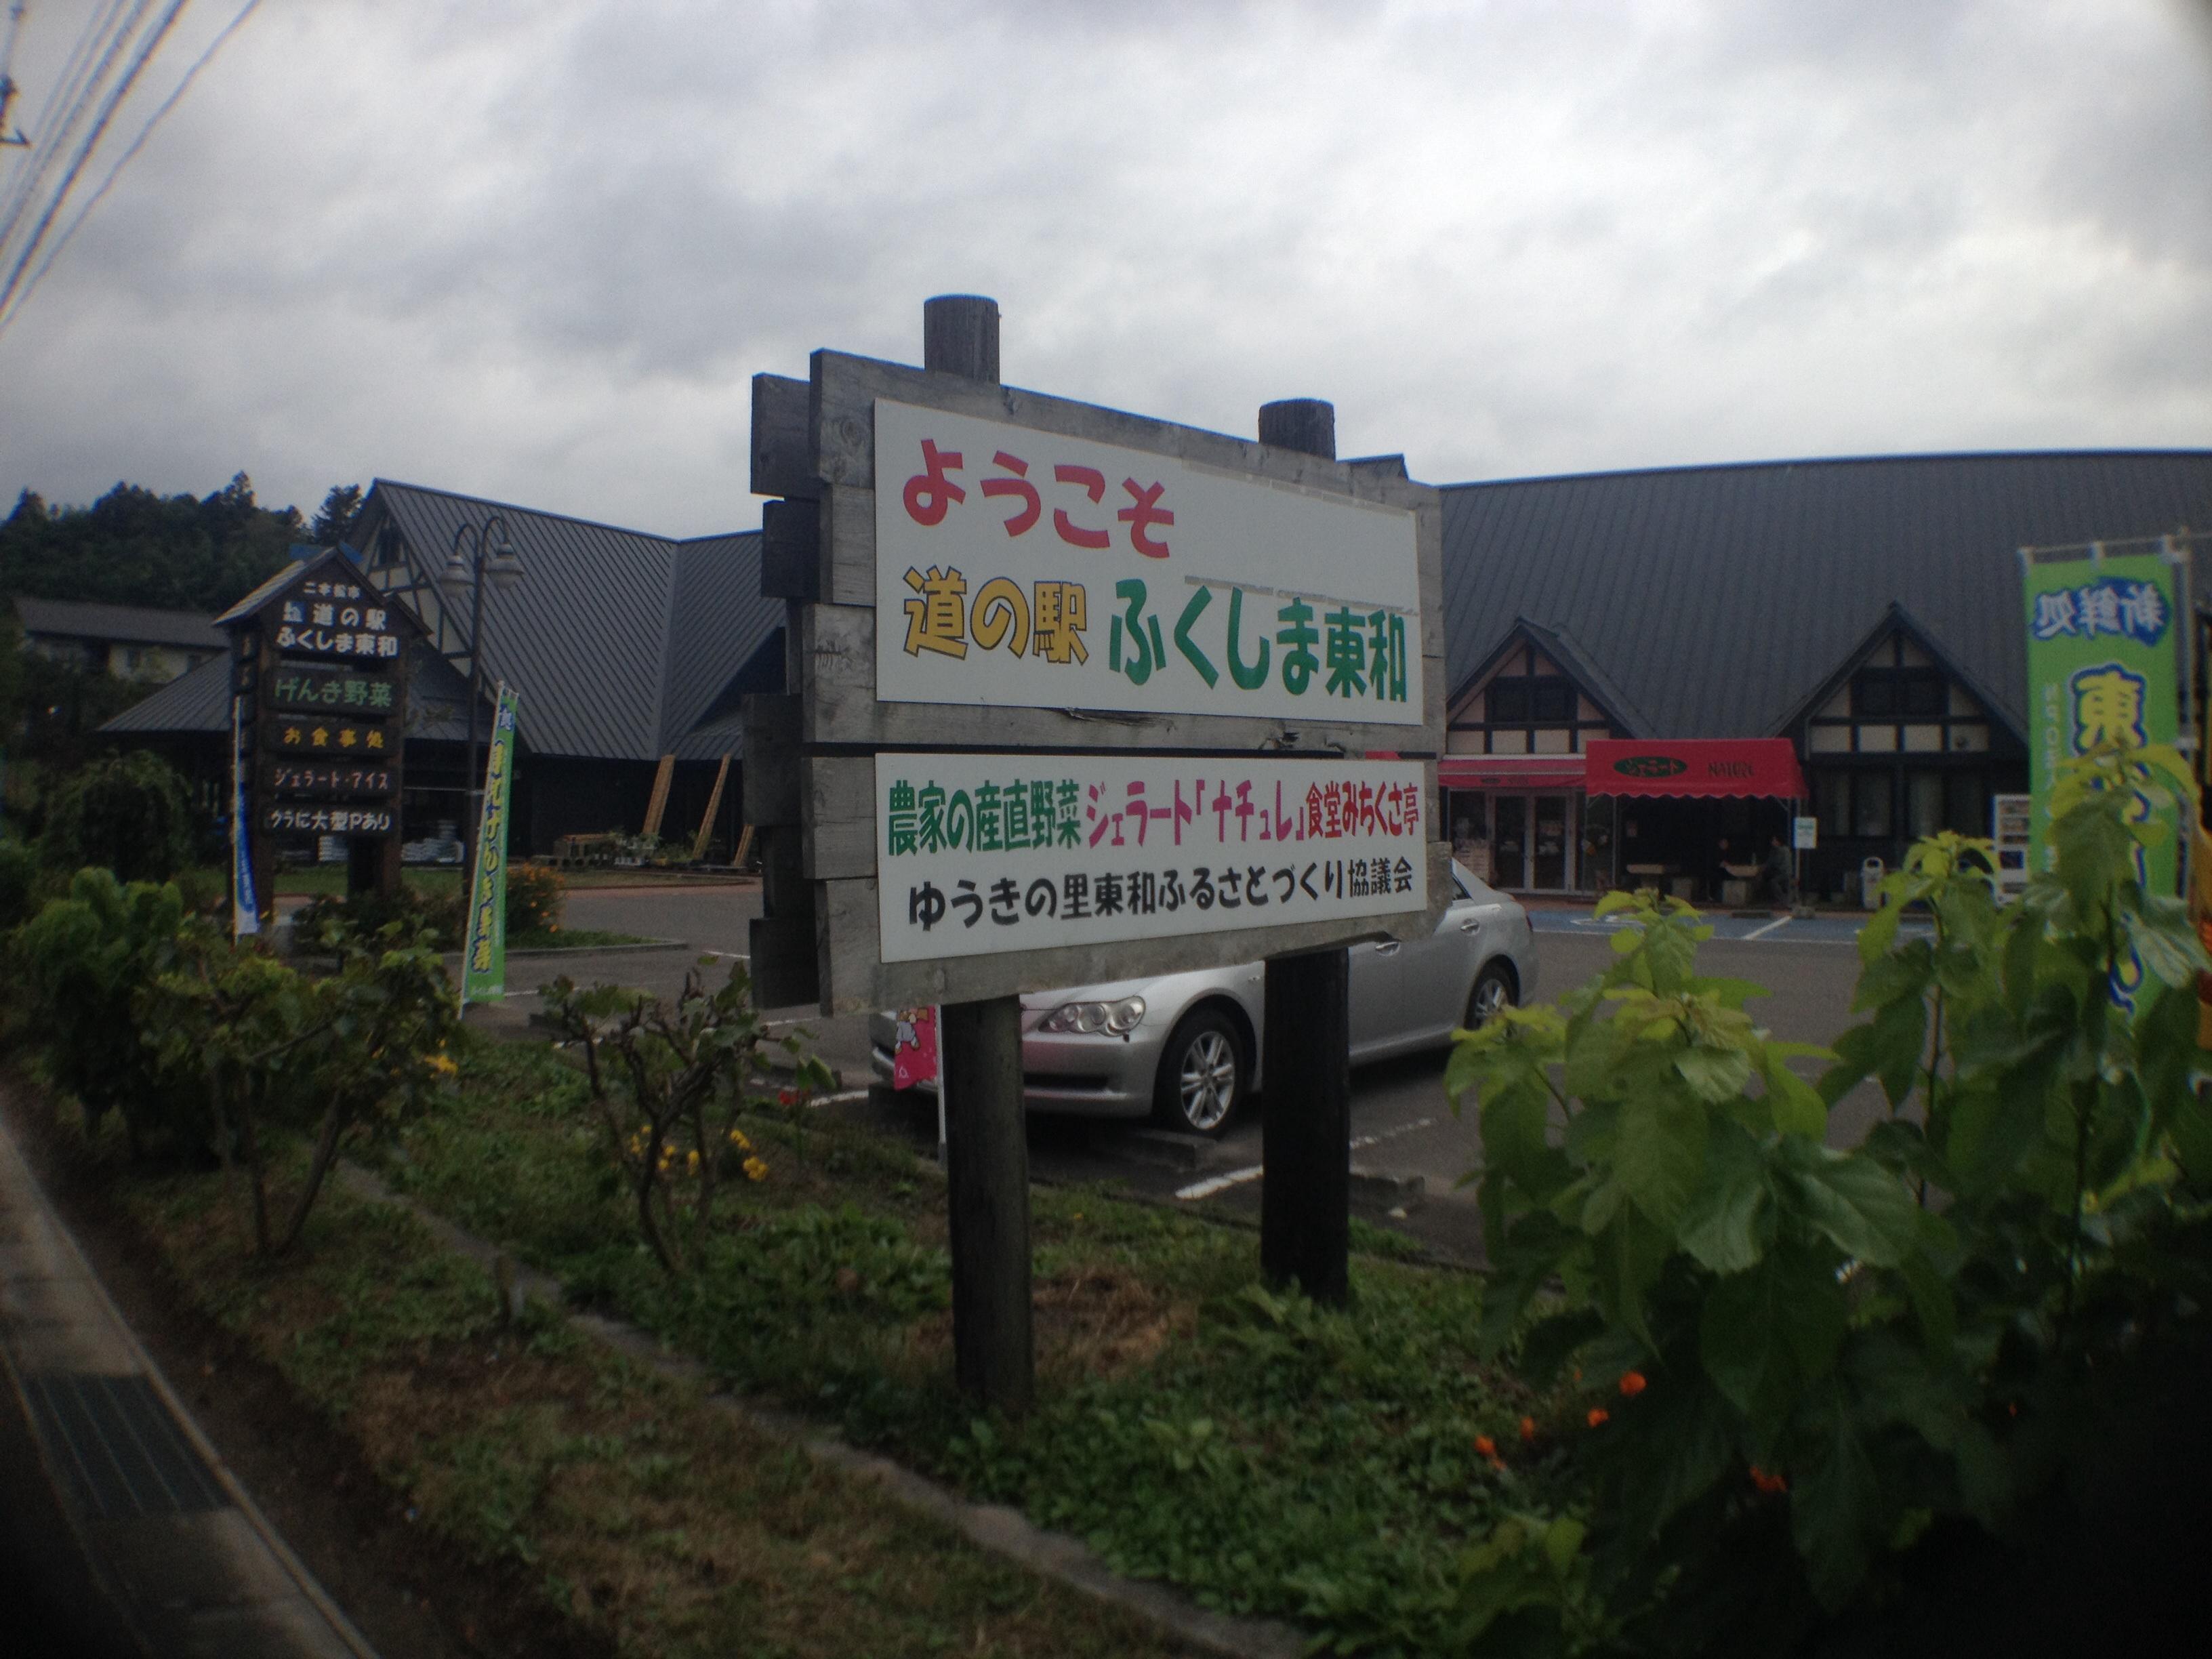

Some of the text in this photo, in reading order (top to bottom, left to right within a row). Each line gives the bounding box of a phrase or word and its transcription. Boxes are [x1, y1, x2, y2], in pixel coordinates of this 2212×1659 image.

[903, 439, 1174, 558] ようこそ
[276, 626, 398, 658] ふくしま東和
[312, 602, 387, 630] 道の駅
[903, 565, 1407, 701] 道の駅 ふくしま東和
[274, 678, 392, 708] げんき野菜
[283, 726, 384, 749] お食事処
[888, 779, 1082, 856] 農家の産直野菜
[1305, 780, 1419, 840] 食堂みちくさ亭
[909, 856, 1413, 932] ゆうきの里東和ふるさとづくり協議会
